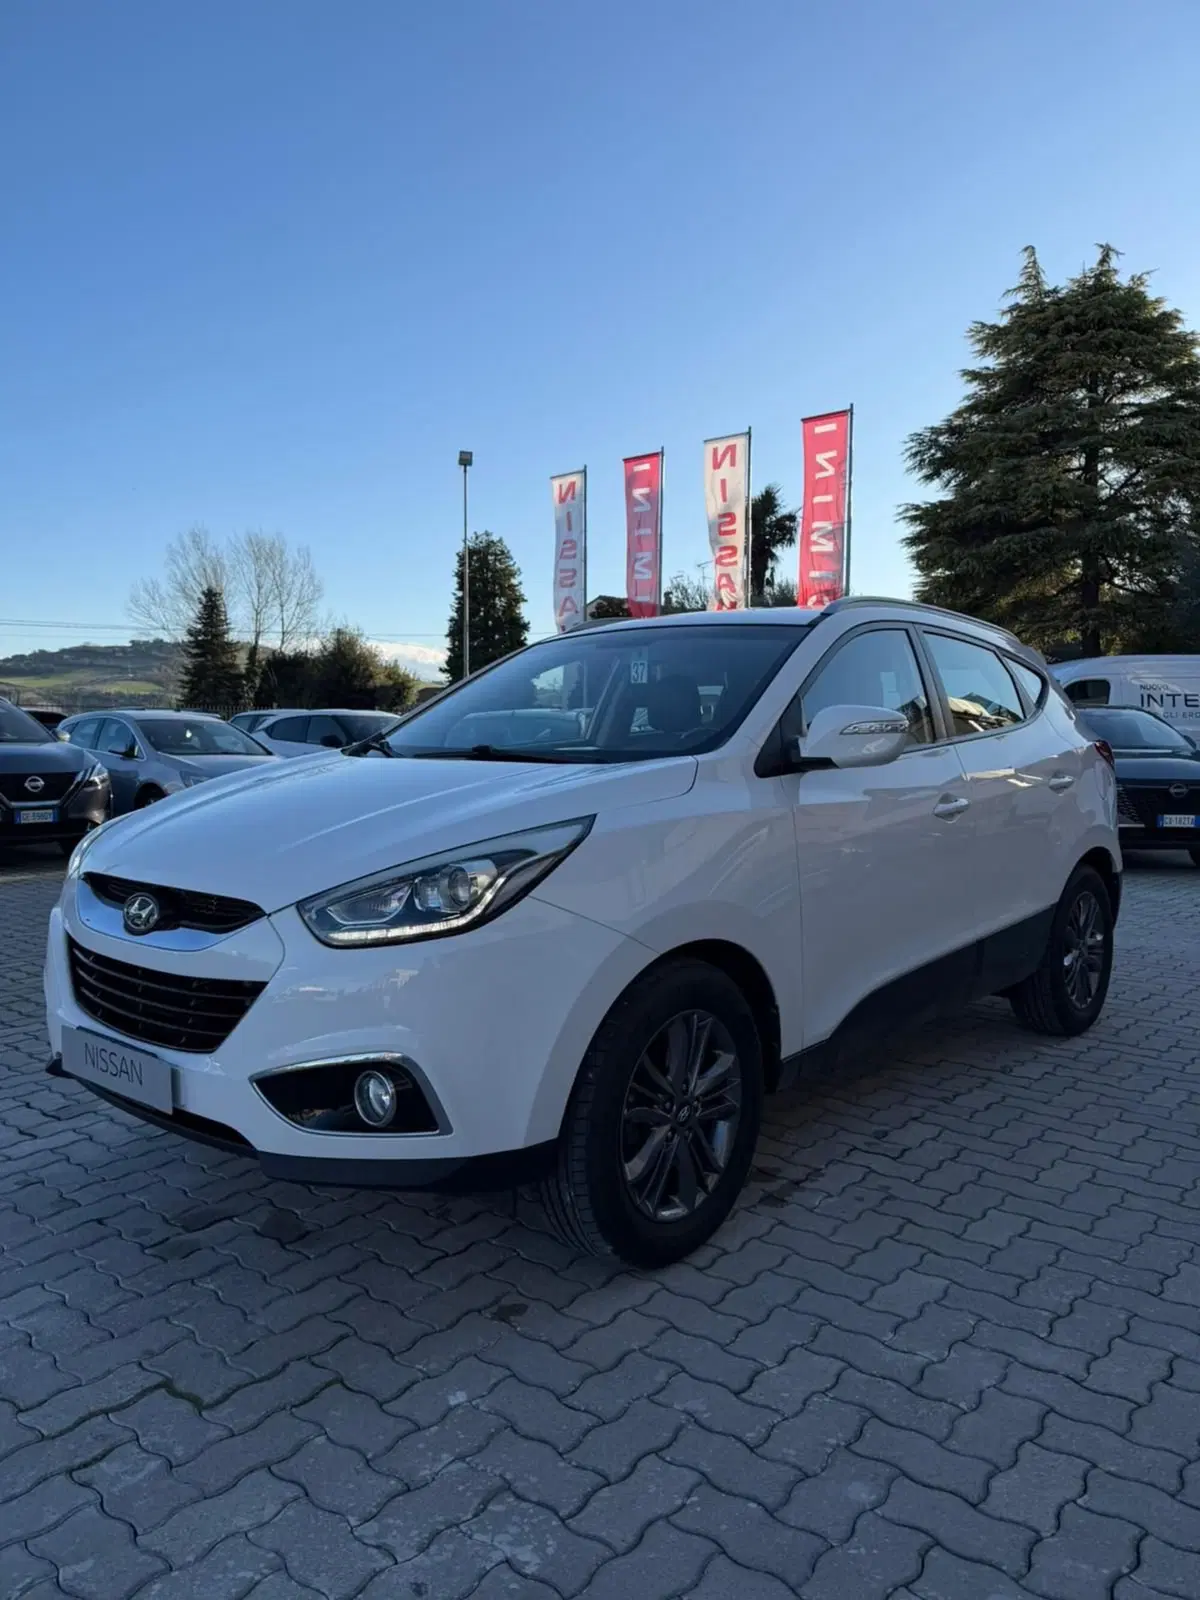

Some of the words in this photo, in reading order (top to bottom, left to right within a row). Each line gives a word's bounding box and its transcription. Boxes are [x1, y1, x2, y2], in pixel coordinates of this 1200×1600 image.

[632, 662, 646, 682] 37
[1140, 693, 1200, 708] INTE
[84, 1041, 144, 1087] NISSAN
